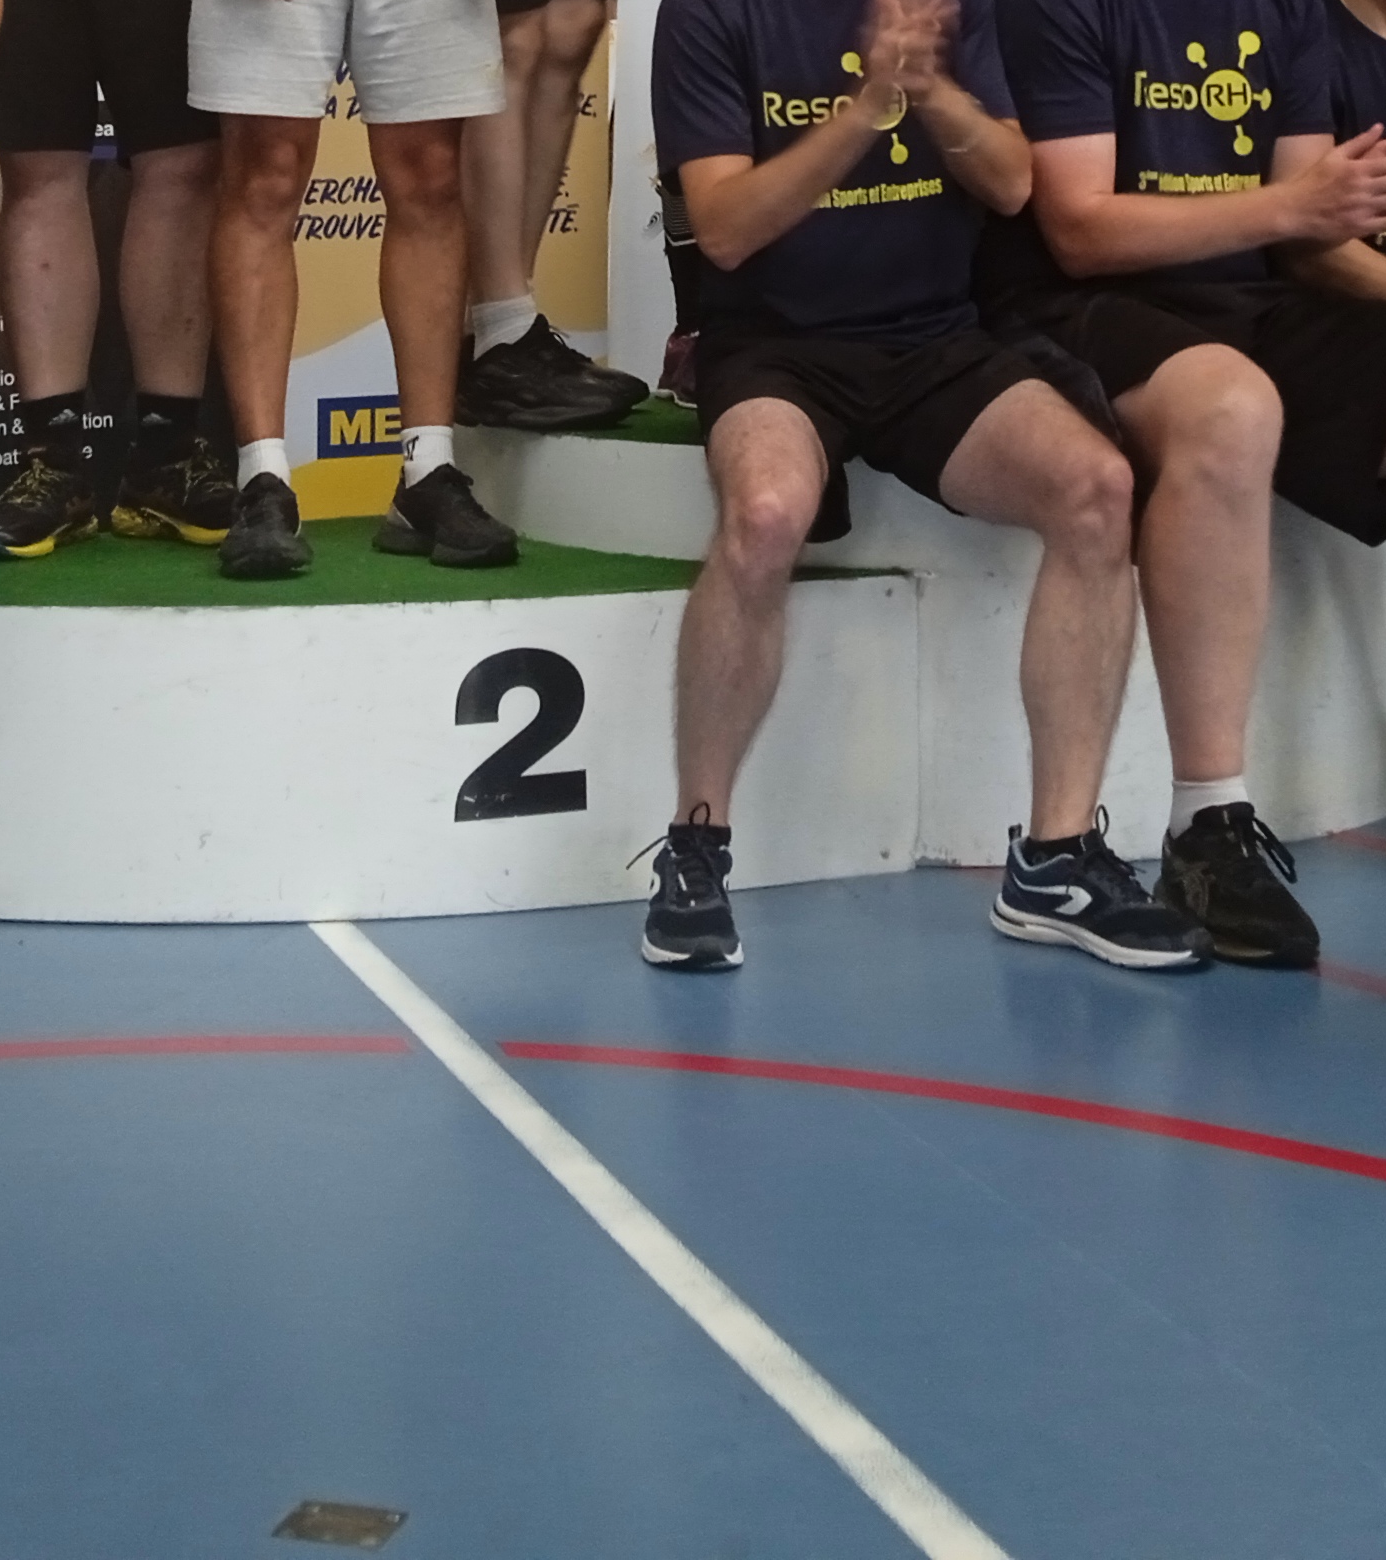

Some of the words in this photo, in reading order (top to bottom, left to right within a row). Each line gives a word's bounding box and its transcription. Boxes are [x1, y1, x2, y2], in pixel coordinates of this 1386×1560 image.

[11, 418, 25, 435] &
[329, 407, 402, 446] ME
[454, 647, 588, 823] 2
